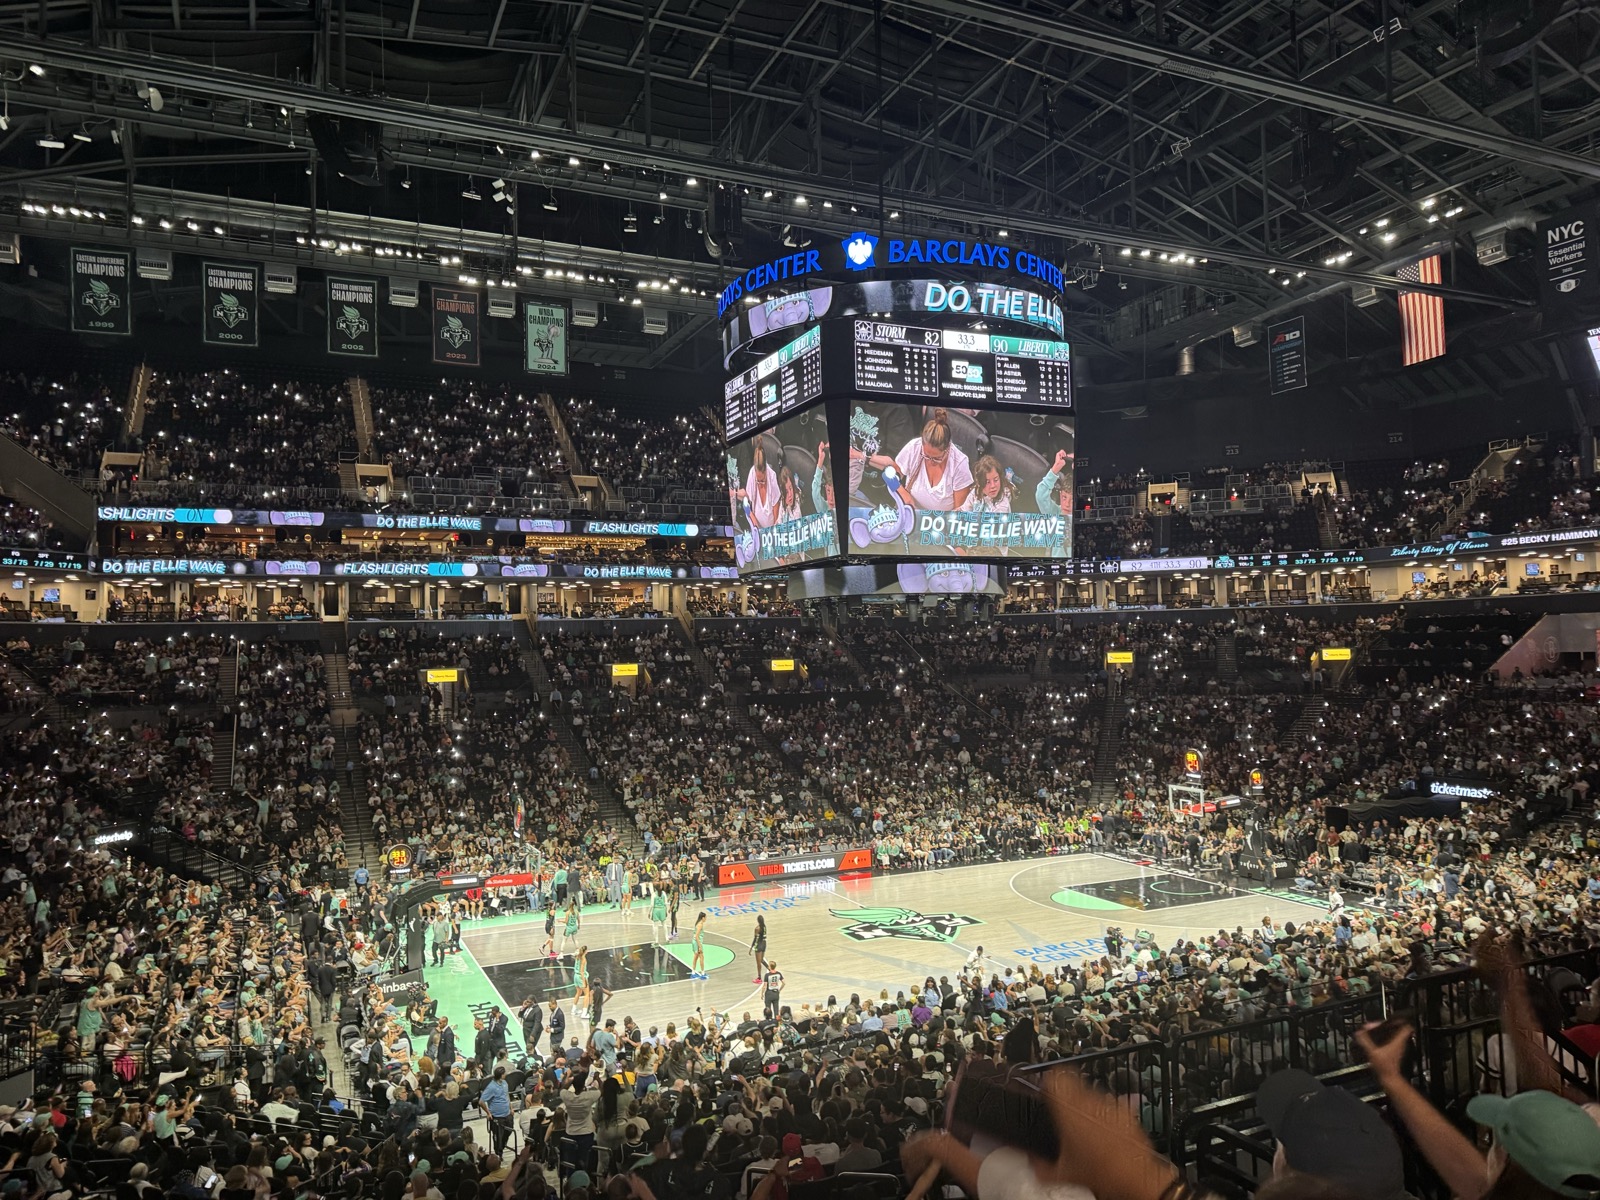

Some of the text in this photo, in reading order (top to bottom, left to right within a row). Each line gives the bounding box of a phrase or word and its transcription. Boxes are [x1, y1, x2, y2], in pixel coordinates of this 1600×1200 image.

[1547, 221, 1584, 244] NYC
[1548, 241, 1585, 258] Essential
[76, 254, 125, 266] EASTERN CONFERENCE
[1548, 252, 1582, 266] Workers
[76, 262, 125, 278] CHAMPIONS
[208, 268, 253, 280] EASTERN CONFERENCE
[745, 250, 822, 292] CENTER
[888, 240, 1064, 294] BARCLAYS CENTER
[208, 276, 253, 291] CHAMPIONS
[332, 282, 373, 294] EASTERN CONFERENCE
[332, 290, 373, 304] CHAMPIONS
[924, 282, 971, 312] DO
[977, 288, 1024, 319] THE
[436, 301, 474, 314] CHAMPIONS
[529, 315, 564, 328] CHAMPIONS
[876, 324, 906, 339] STORM
[924, 331, 939, 346] 82
[1272, 330, 1300, 345] A10
[958, 334, 975, 345] 33.3
[994, 340, 1008, 352] 90
[1018, 340, 1051, 354] LIBERTY
[780, 350, 787, 364] 90
[750, 368, 757, 382] 82
[865, 365, 899, 373] MELBOURNE
[955, 365, 968, 374] 50
[186, 509, 204, 522] ON
[376, 517, 482, 530] DO THE ELLIE WAVE
[588, 522, 658, 533] FLASHLIGHTS
[666, 524, 679, 534] ON
[921, 516, 945, 532] DO
[948, 519, 978, 537] THE
[980, 521, 1021, 538] ELLIE
[1024, 520, 1065, 536] WAVE
[762, 532, 772, 547] DO
[773, 531, 788, 546] THE
[789, 525, 809, 545] ELLIE
[810, 516, 833, 538] WAVE
[1501, 530, 1598, 546] #25 BECKY HAMMON
[1390, 541, 1489, 557] Liberty Ring Of Honor
[103, 560, 226, 574] DO THE ELLIE WAVE
[343, 563, 428, 575] FLASHLIGHTS
[438, 562, 454, 574] ON
[1131, 562, 1142, 571] 82
[1189, 560, 1202, 568] 90
[584, 566, 672, 578] DO THE ELLIE WAVE
[1430, 781, 1494, 799] ticketmast
[394, 857, 406, 866] 24
[758, 858, 835, 876] WNBATICKETS.COM
[706, 894, 810, 912] BARCLAYS
[715, 903, 800, 917] CENTER
[1013, 938, 1105, 957] BARCLA
[1031, 946, 1109, 963] CENTE
